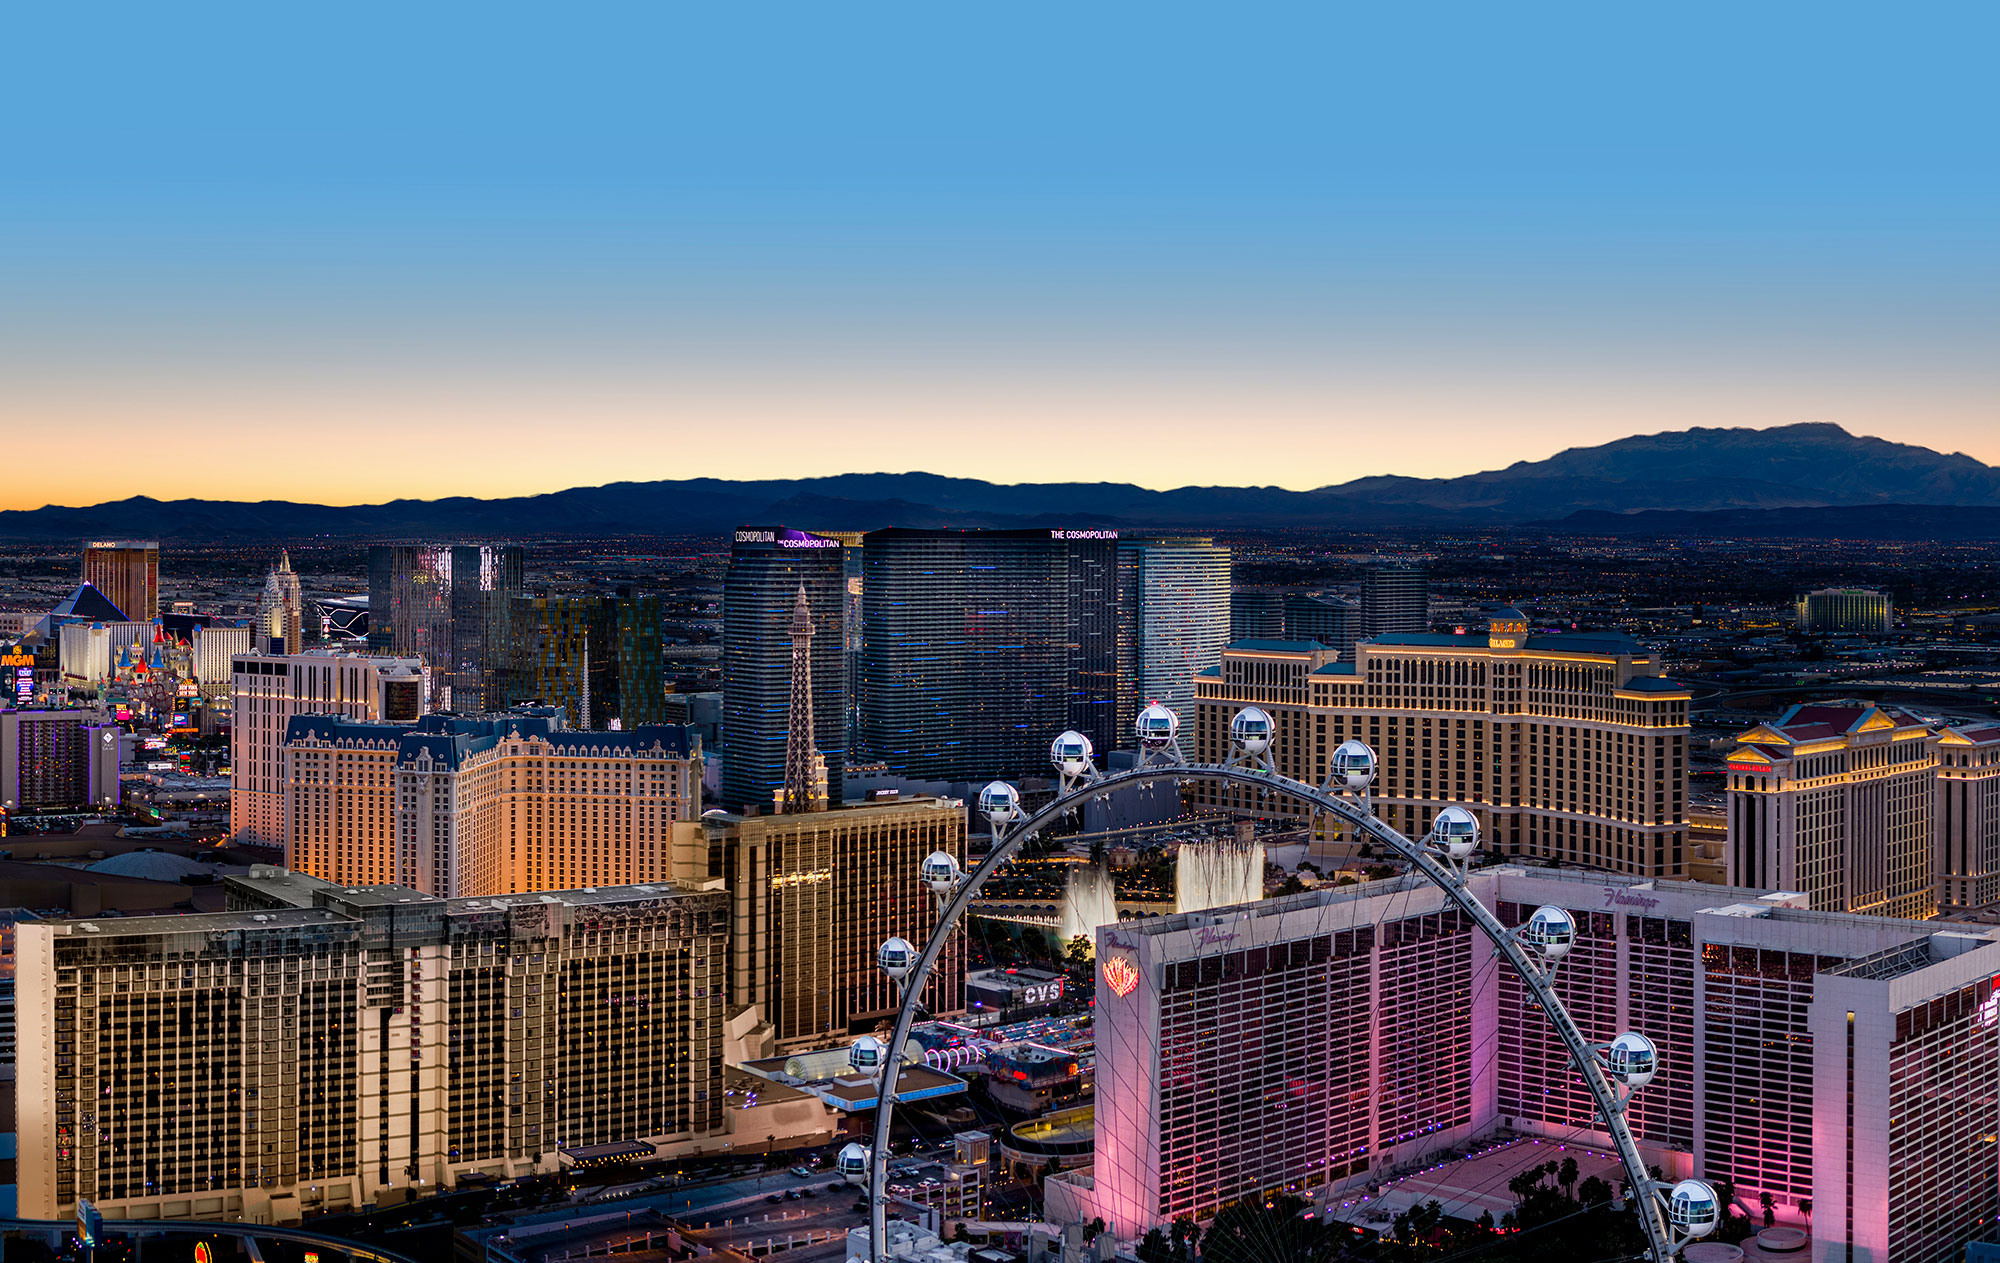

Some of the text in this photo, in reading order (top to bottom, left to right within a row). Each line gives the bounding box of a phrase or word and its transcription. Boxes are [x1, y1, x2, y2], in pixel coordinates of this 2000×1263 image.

[735, 531, 775, 542] COSMOPOLITAN
[1051, 530, 1118, 539] THE COSMOPOLITAN
[783, 539, 840, 549] COSMOPOLITAN
[1, 655, 35, 667] MGM
[1604, 887, 1660, 912] Flamingo
[1024, 983, 1060, 1004] CVS
